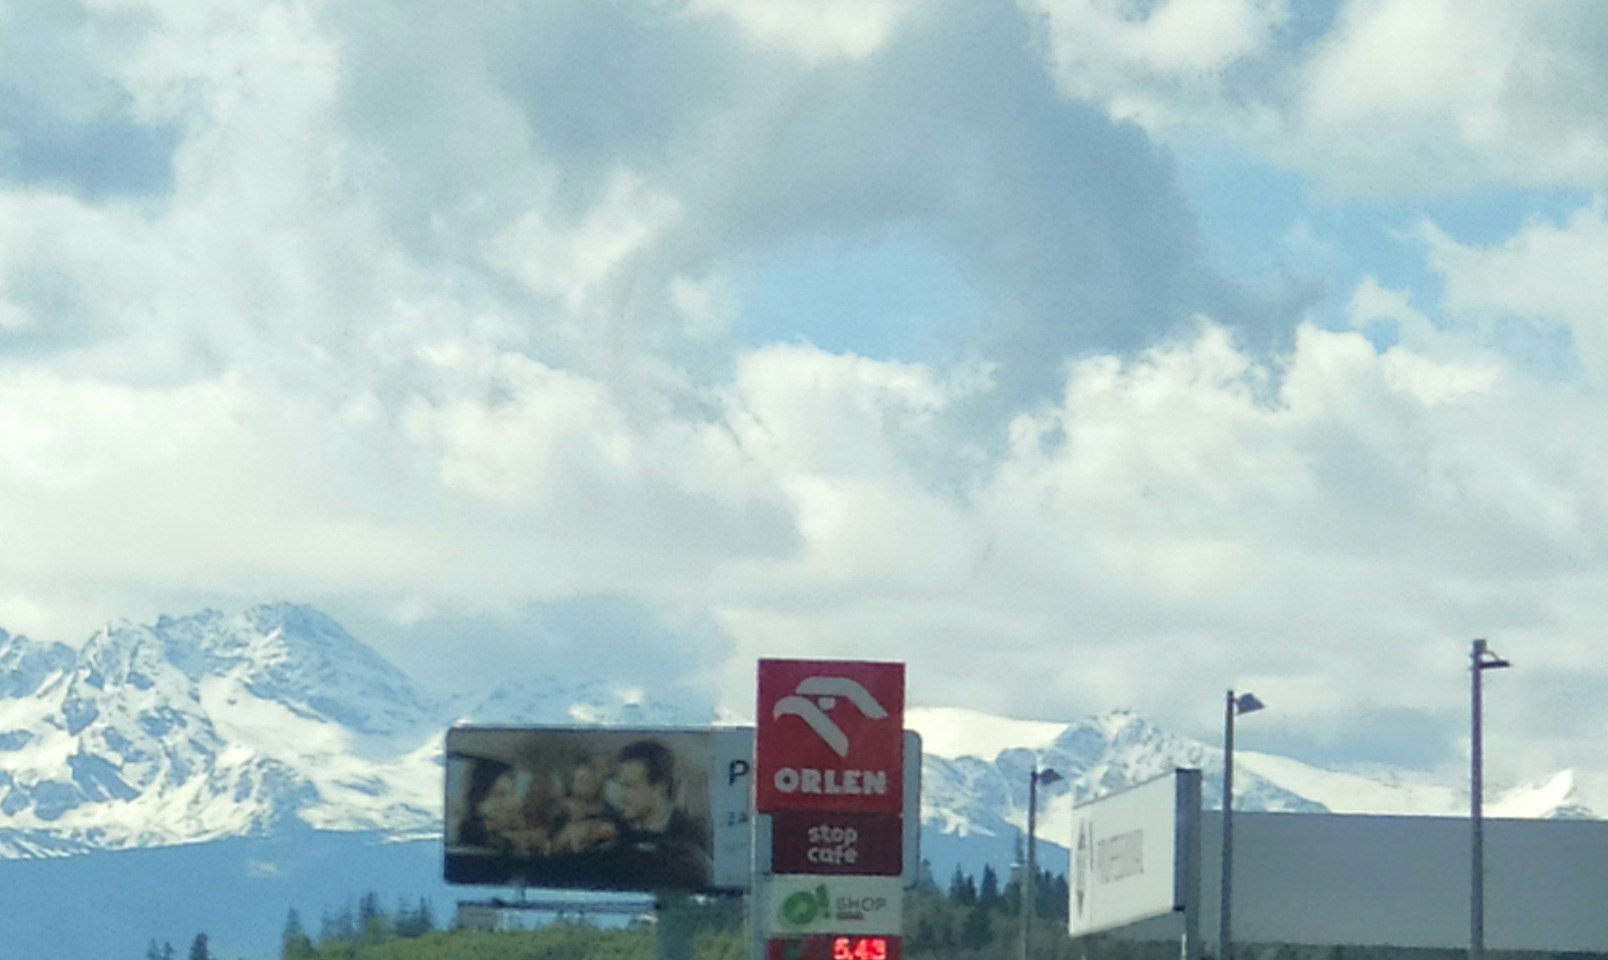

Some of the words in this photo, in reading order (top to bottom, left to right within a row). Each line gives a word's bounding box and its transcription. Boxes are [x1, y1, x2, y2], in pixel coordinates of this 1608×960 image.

[773, 767, 888, 795] ORLEN
[807, 825, 858, 849] stop
[836, 895, 887, 912] SHOP
